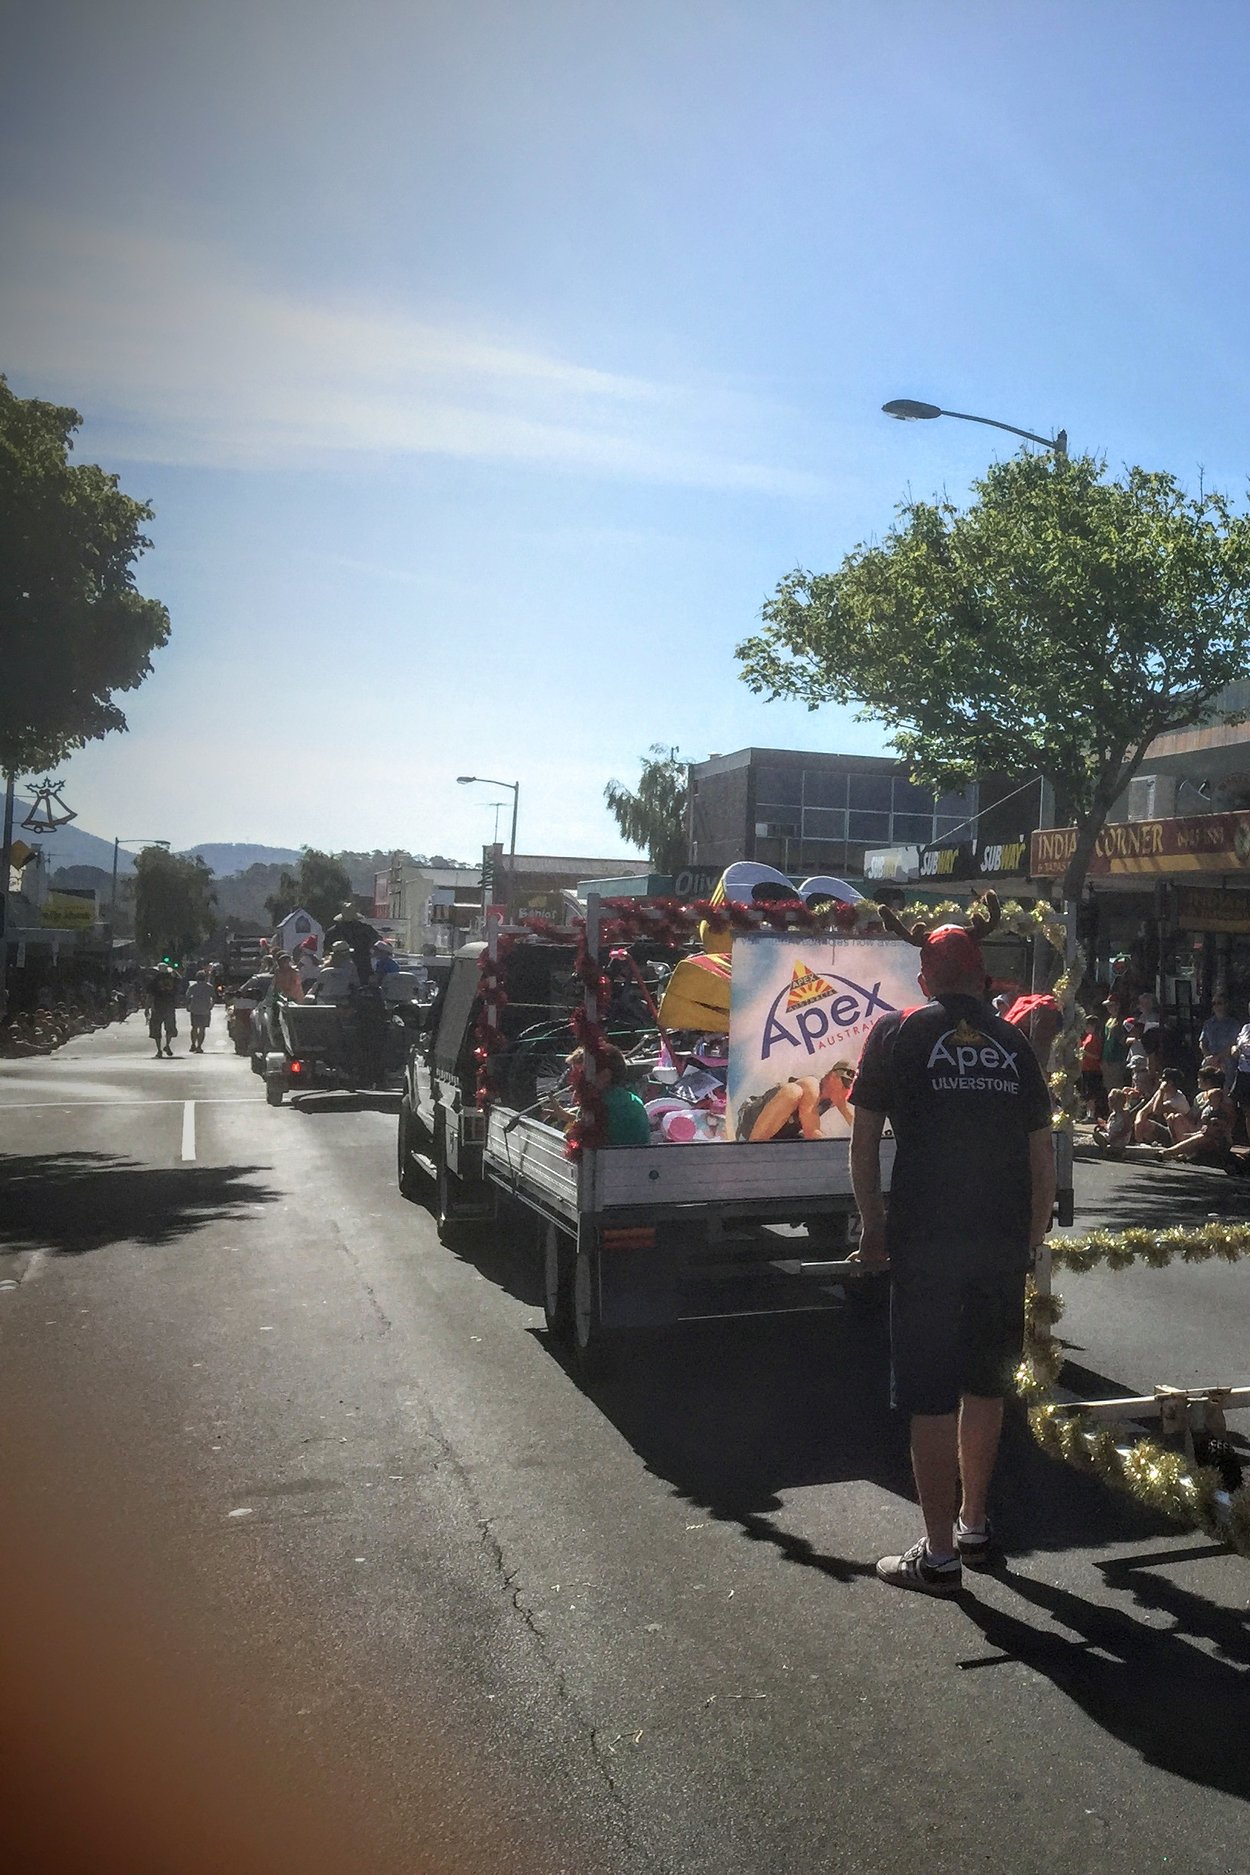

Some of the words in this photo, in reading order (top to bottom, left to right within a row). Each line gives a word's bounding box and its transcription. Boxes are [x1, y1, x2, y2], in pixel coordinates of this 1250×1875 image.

[1038, 831, 1078, 860] INDIA
[1094, 823, 1164, 858] CORNER
[920, 848, 959, 875] SUBWAY
[980, 842, 1026, 872] SUBWAY
[675, 872, 717, 896] Oliv
[761, 977, 898, 1060] Apex
[818, 1020, 874, 1050] AUSTRA
[926, 1034, 1020, 1077] Apex
[931, 1077, 1020, 1095] ULVERSTONE
